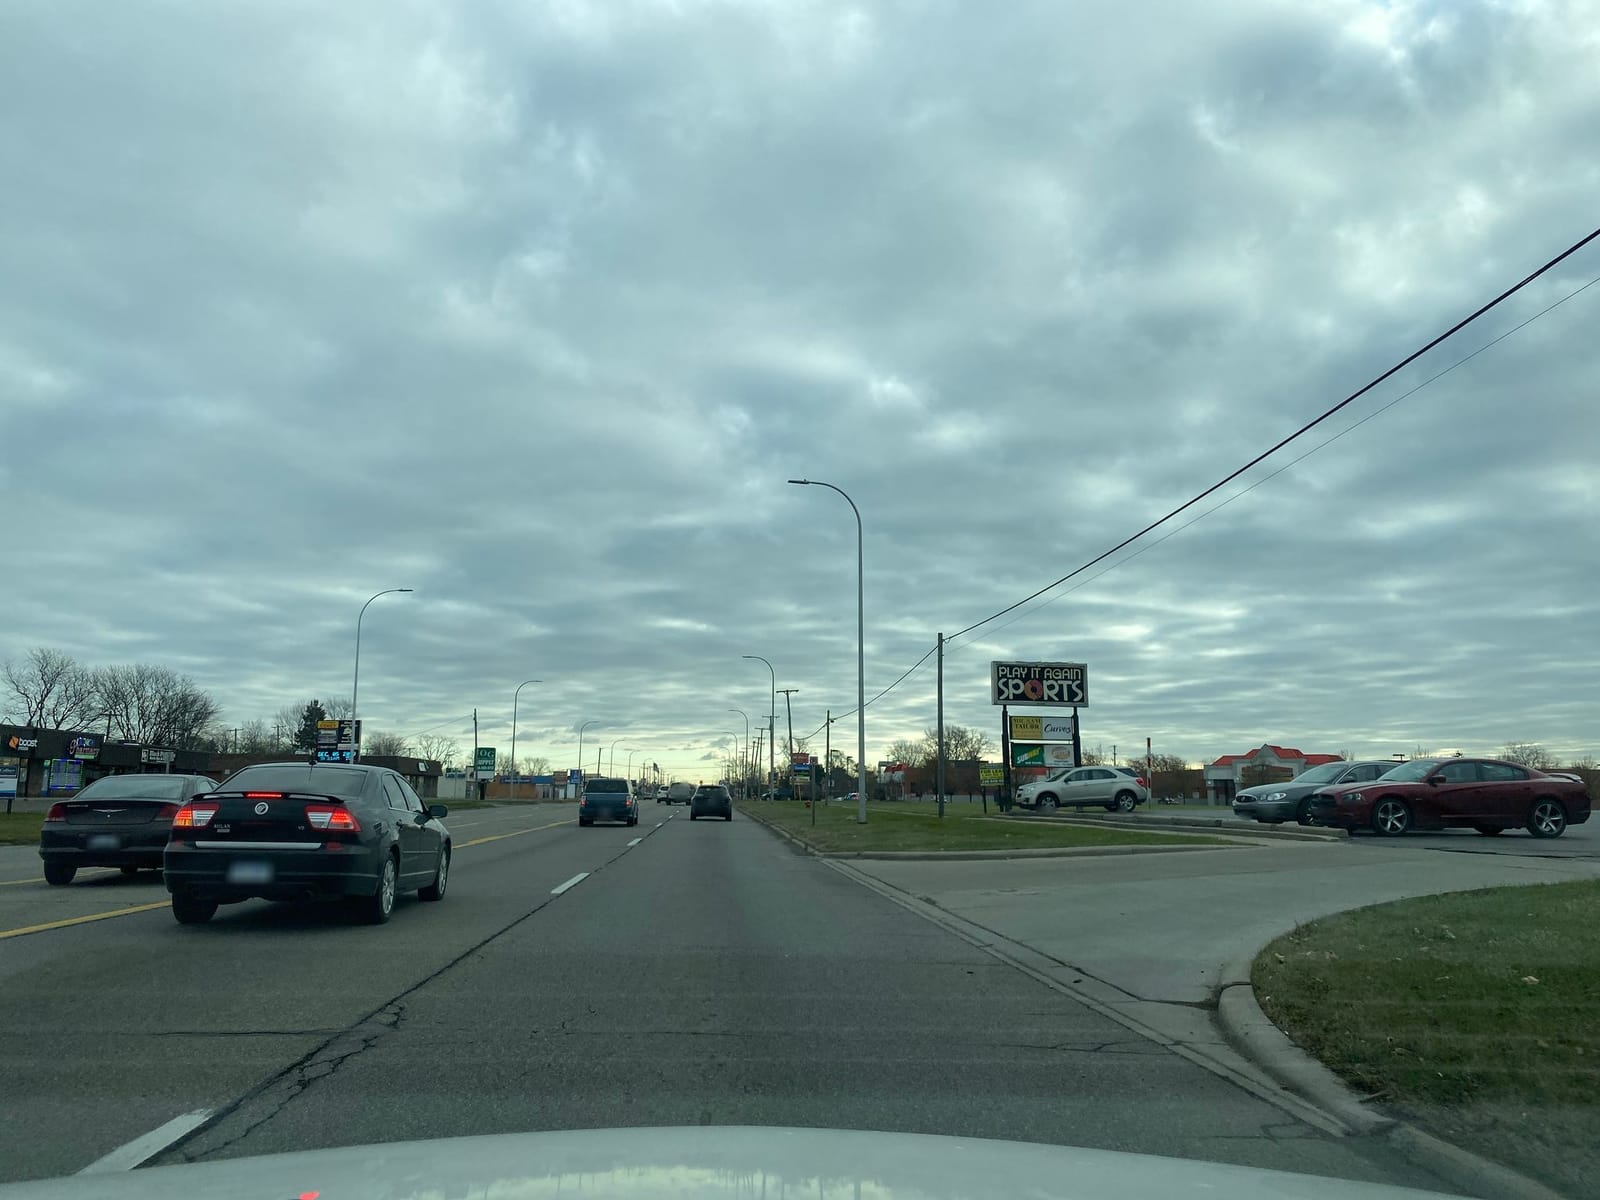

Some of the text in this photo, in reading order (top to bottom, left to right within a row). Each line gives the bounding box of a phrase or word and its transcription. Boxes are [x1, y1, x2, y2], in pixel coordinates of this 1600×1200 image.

[999, 666, 1081, 679] PLAY IT AGAIN
[998, 678, 1083, 701] SPORTS
[1044, 723, 1071, 734] Curves
[19, 737, 38, 747] boost
[1017, 746, 1041, 764] SUBWAY
